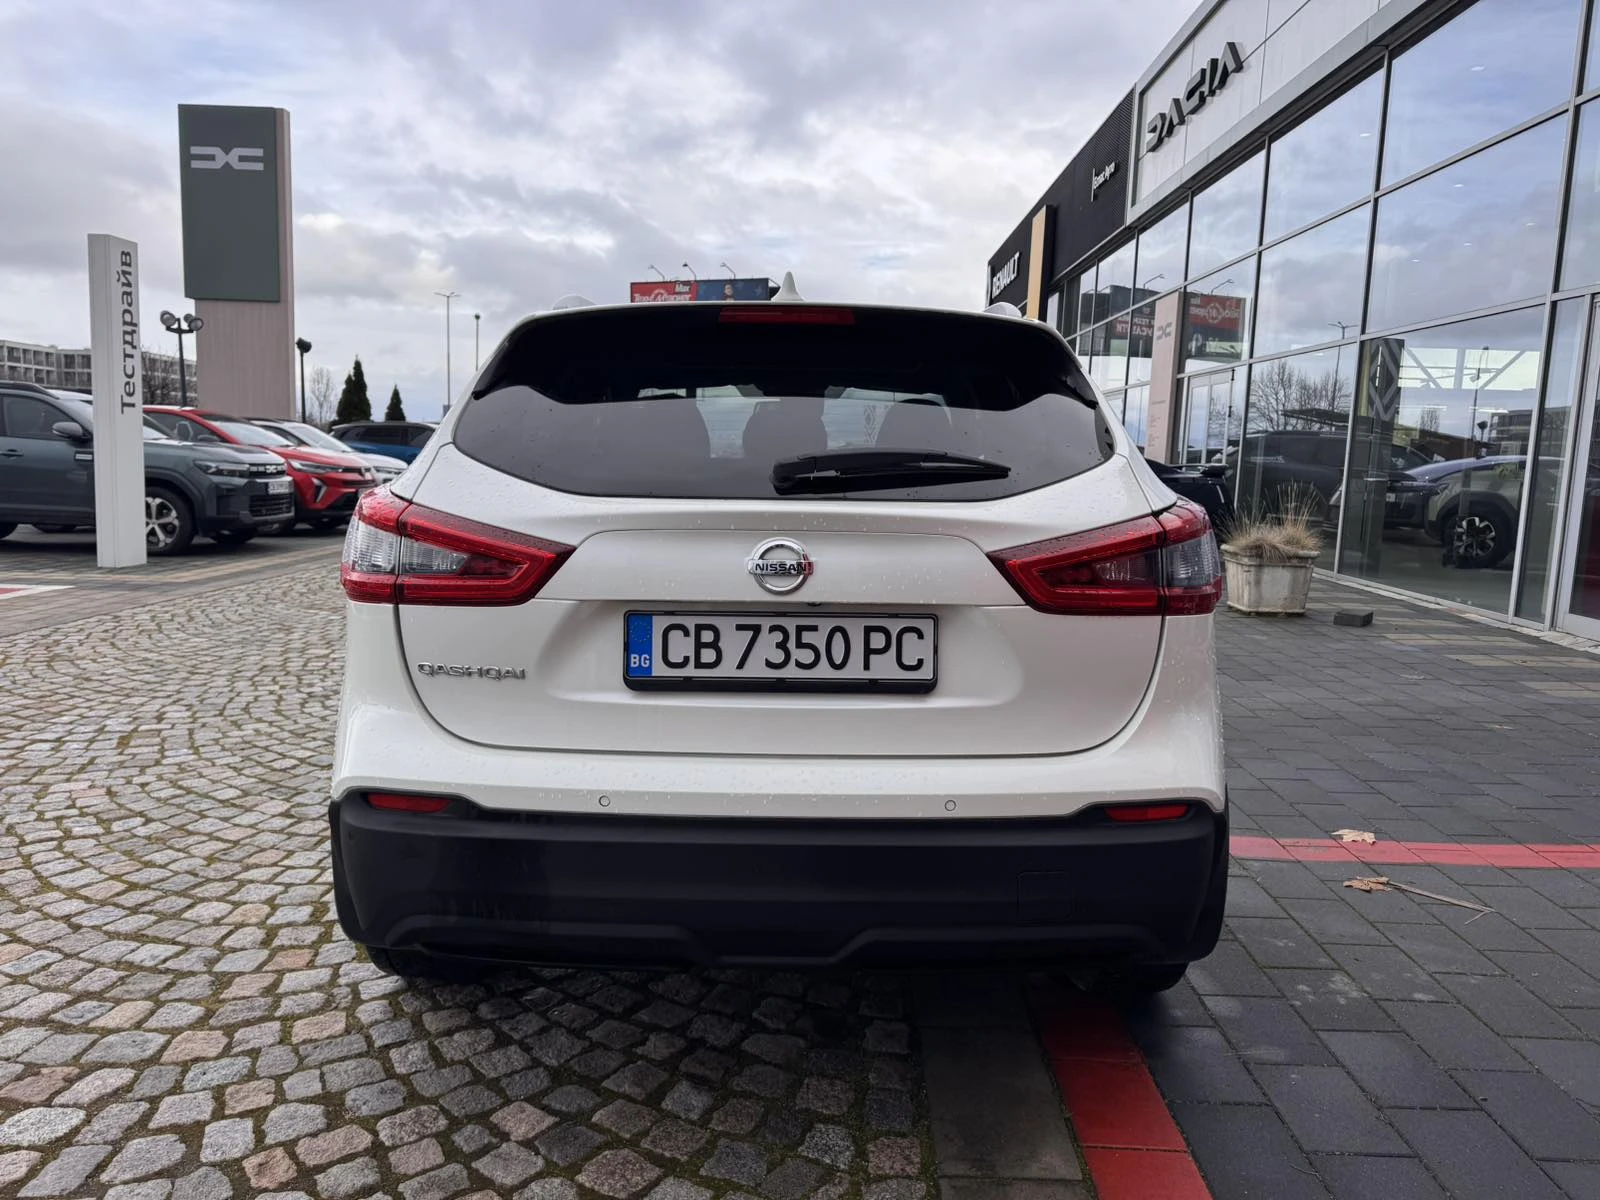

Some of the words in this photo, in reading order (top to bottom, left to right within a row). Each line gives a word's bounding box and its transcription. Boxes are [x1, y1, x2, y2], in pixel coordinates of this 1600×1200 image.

[1146, 42, 1243, 152] DACIA
[117, 250, 138, 414] Тестдрайв
[754, 562, 807, 572] NISSAN
[630, 654, 650, 668] BG
[661, 623, 723, 670] CB
[735, 624, 851, 671] 7350
[863, 625, 925, 672] PC
[417, 662, 526, 681] QASHQAI
